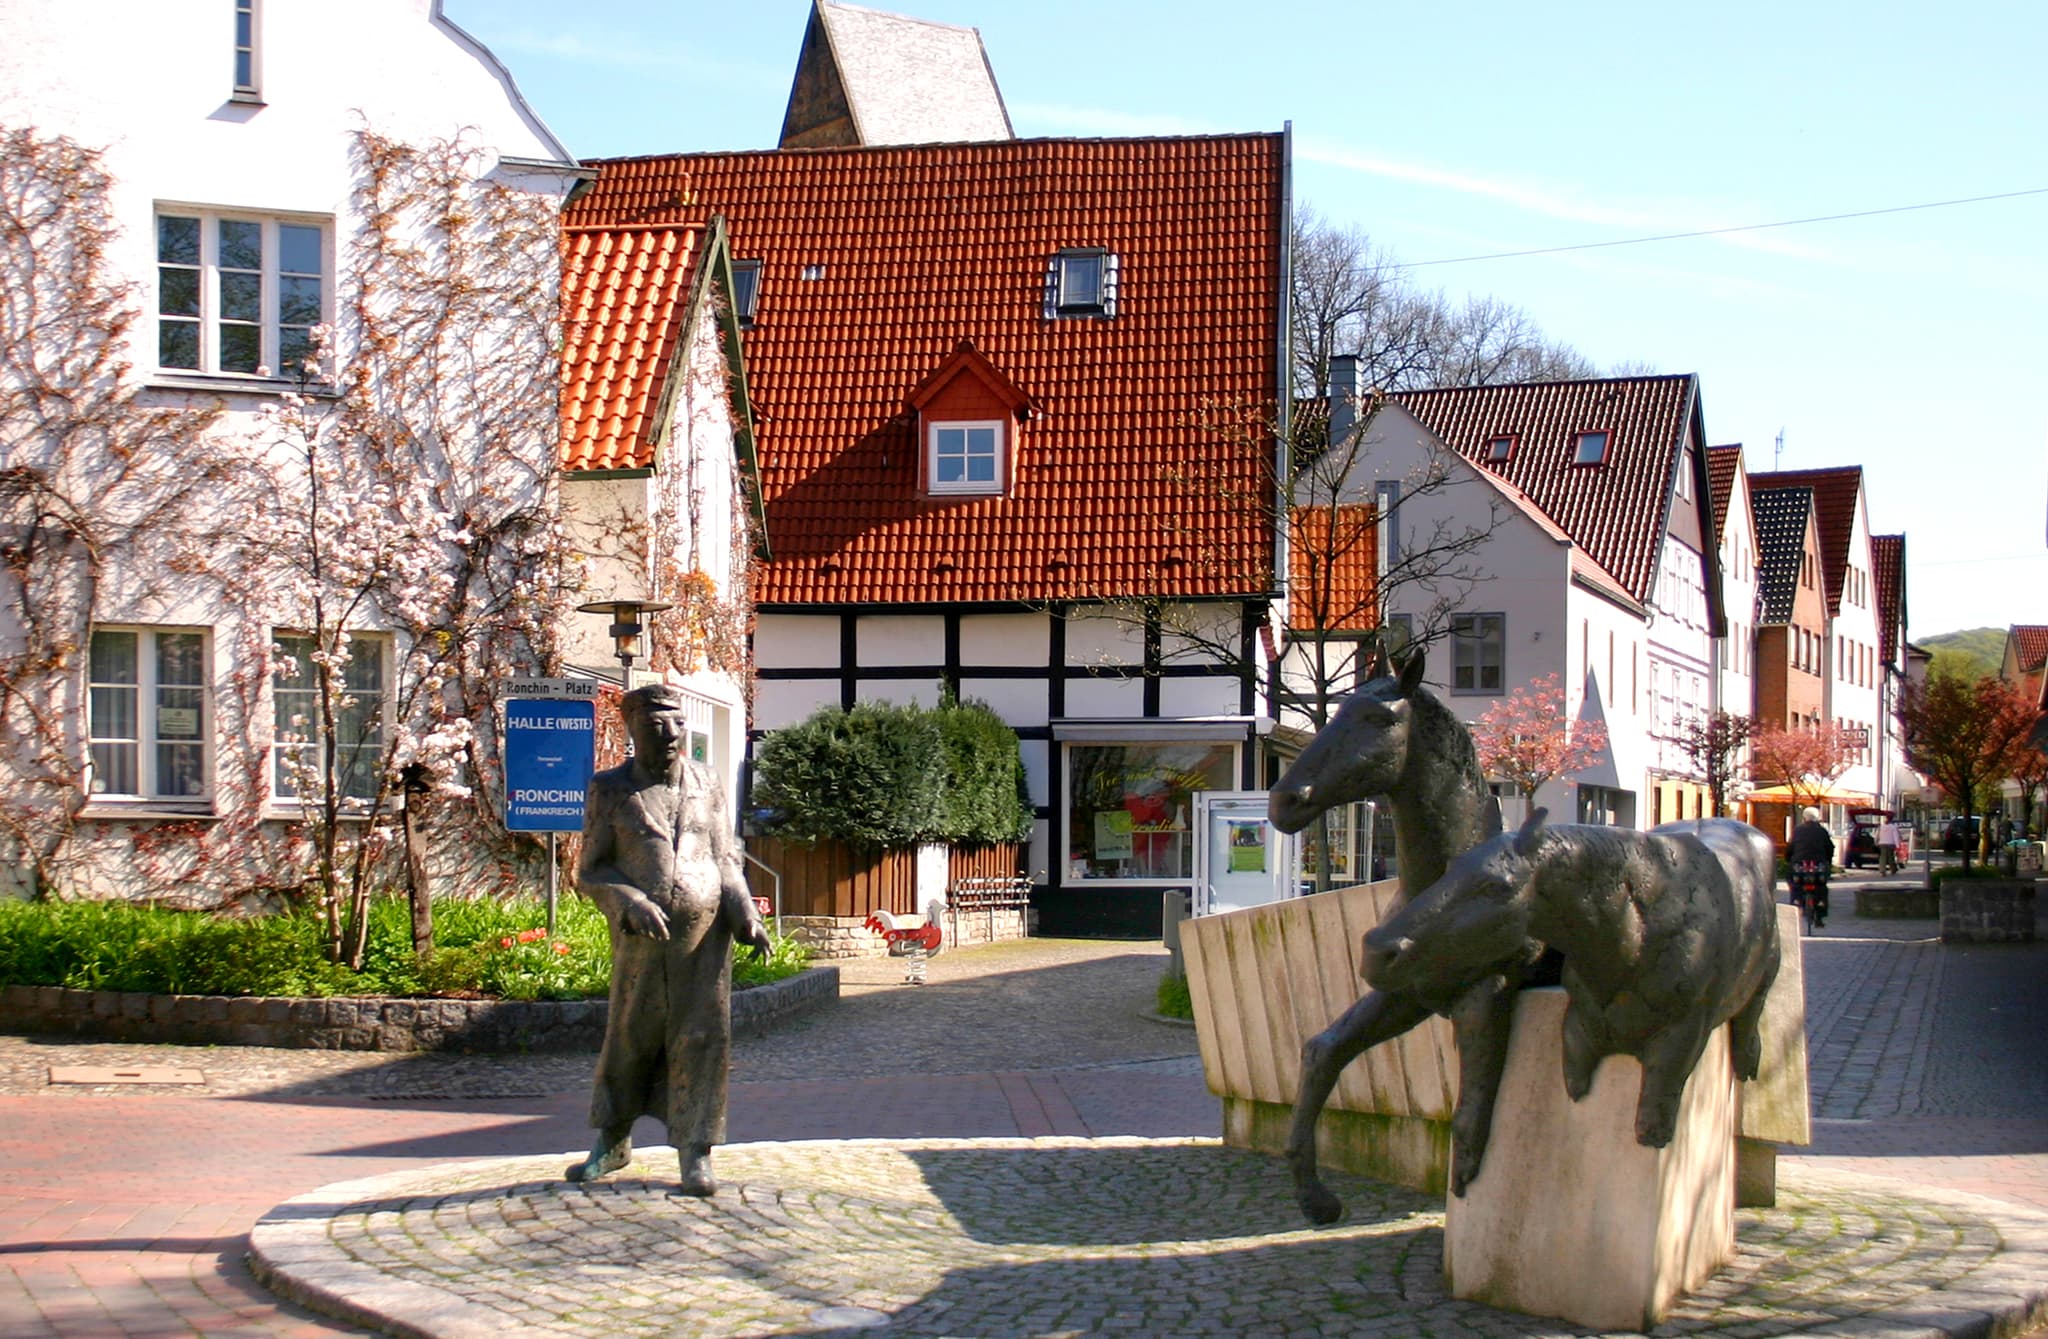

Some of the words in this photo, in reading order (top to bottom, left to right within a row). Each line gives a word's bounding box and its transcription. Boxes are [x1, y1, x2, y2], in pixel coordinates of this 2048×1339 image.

[507, 681, 550, 694] Ronchin
[565, 682, 593, 695] Platz
[508, 717, 555, 730] HALLE
[515, 789, 585, 802] RONCHIN
